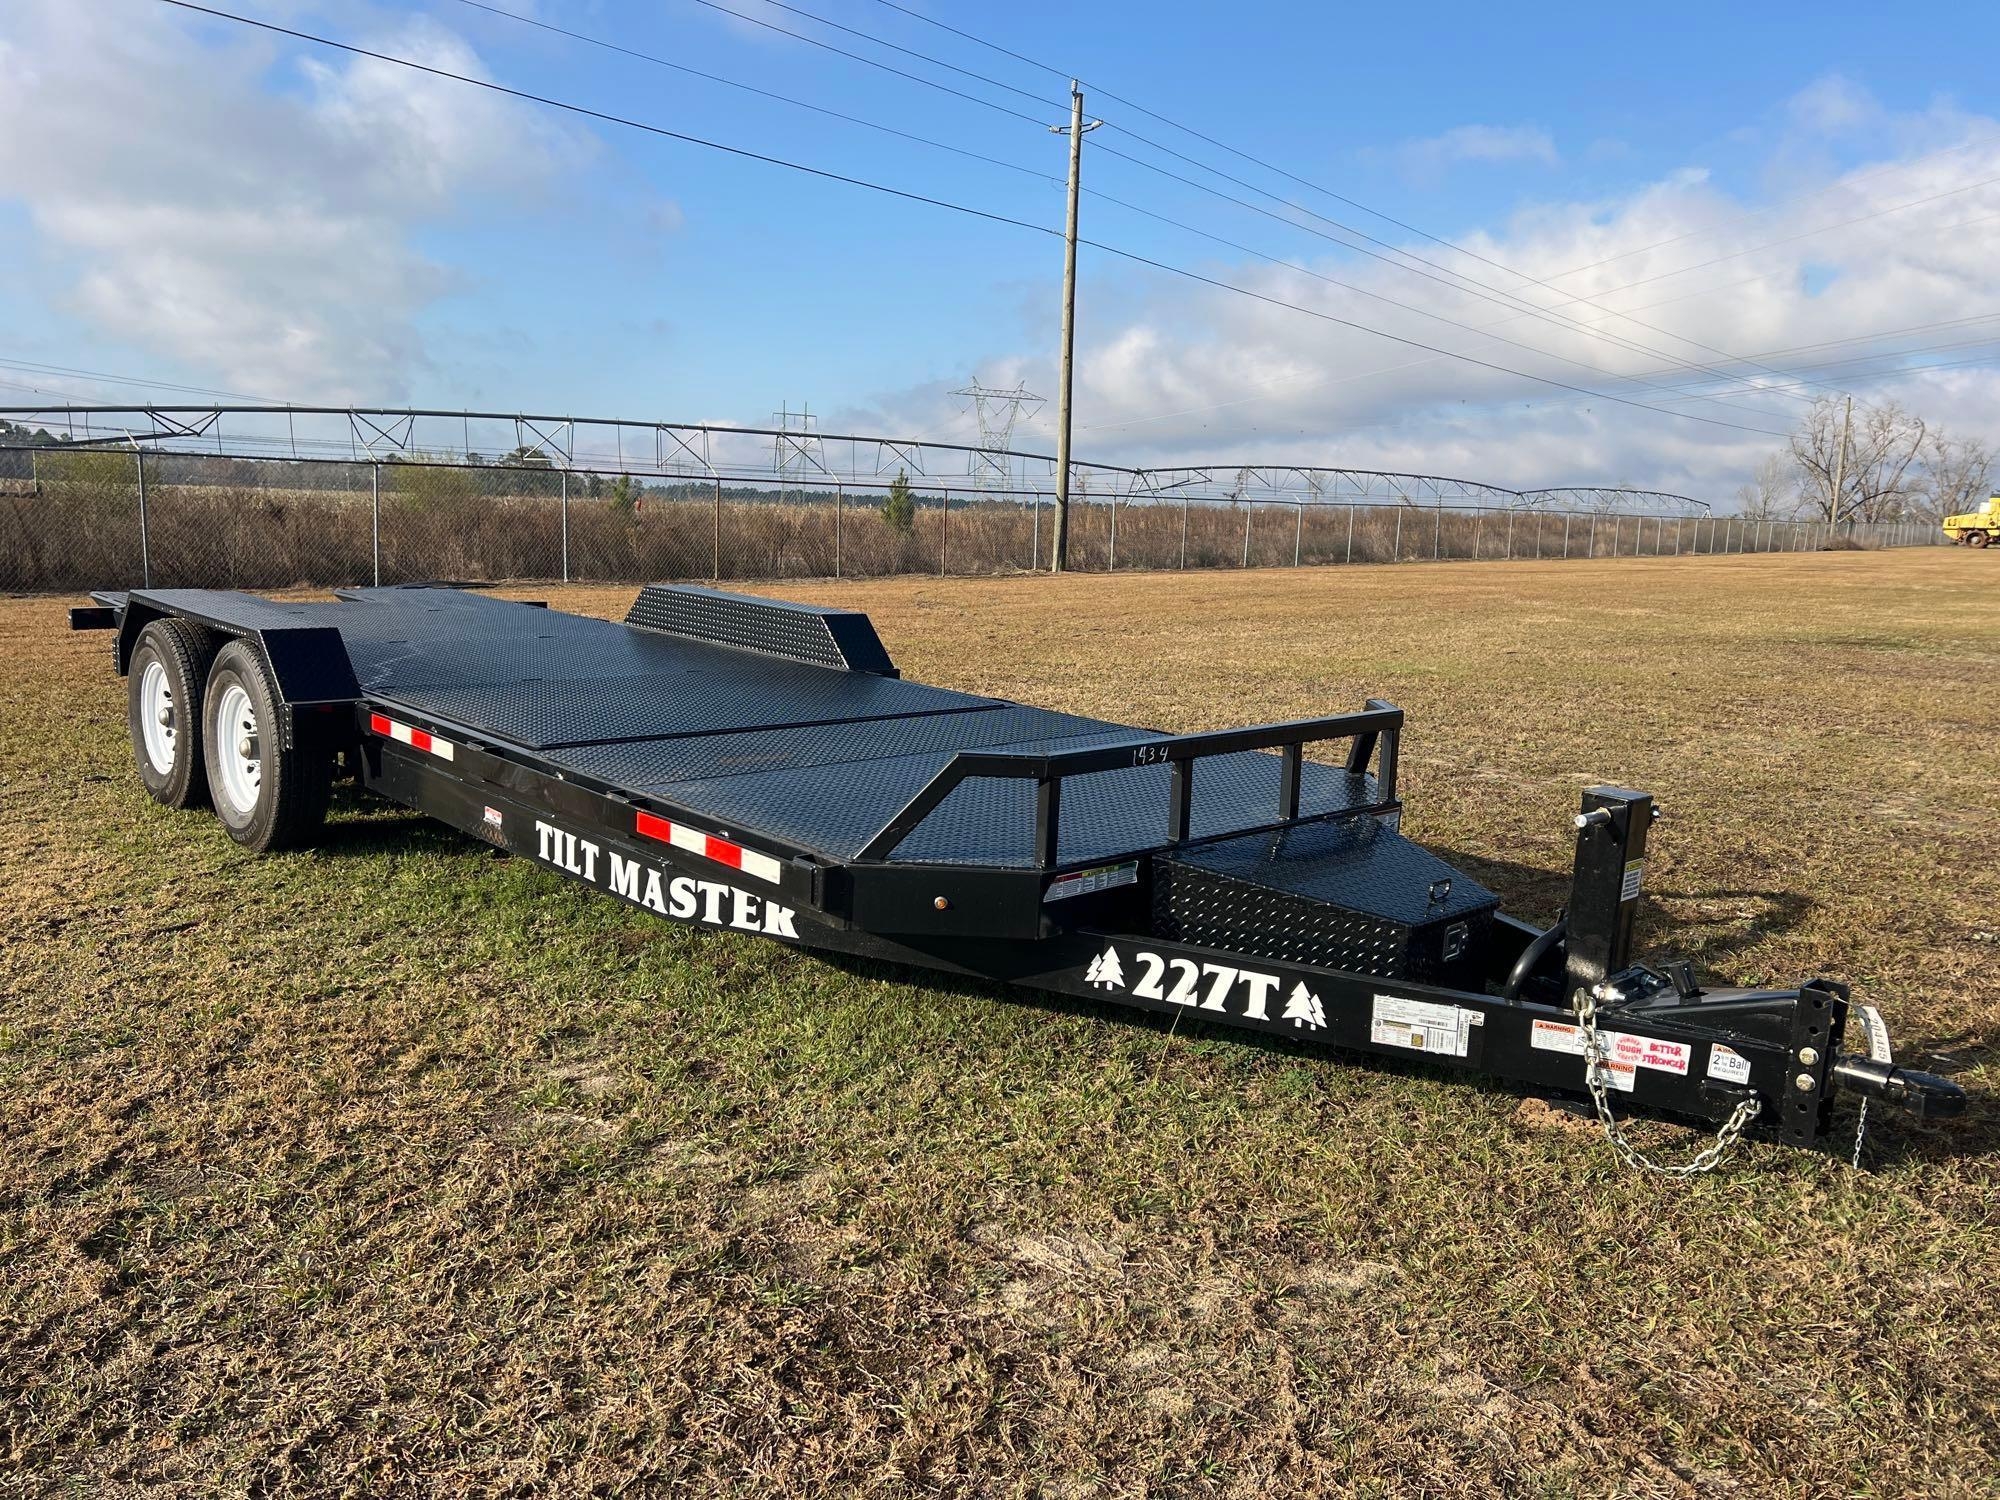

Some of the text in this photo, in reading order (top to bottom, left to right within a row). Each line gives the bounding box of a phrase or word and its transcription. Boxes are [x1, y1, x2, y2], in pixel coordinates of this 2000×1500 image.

[1133, 746, 1169, 766] 1434
[535, 820, 800, 939] TILT MASTER
[1131, 952, 1280, 1021] 227T
[1545, 1024, 1571, 1033] WARNING
[1616, 1044, 1642, 1054] TOUGH
[1650, 1043, 1682, 1056] BETTER
[1642, 1054, 1686, 1070] STRONGER
[1729, 1057, 1748, 1071] Ball
[1713, 1066, 1745, 1076] REQUIRED
